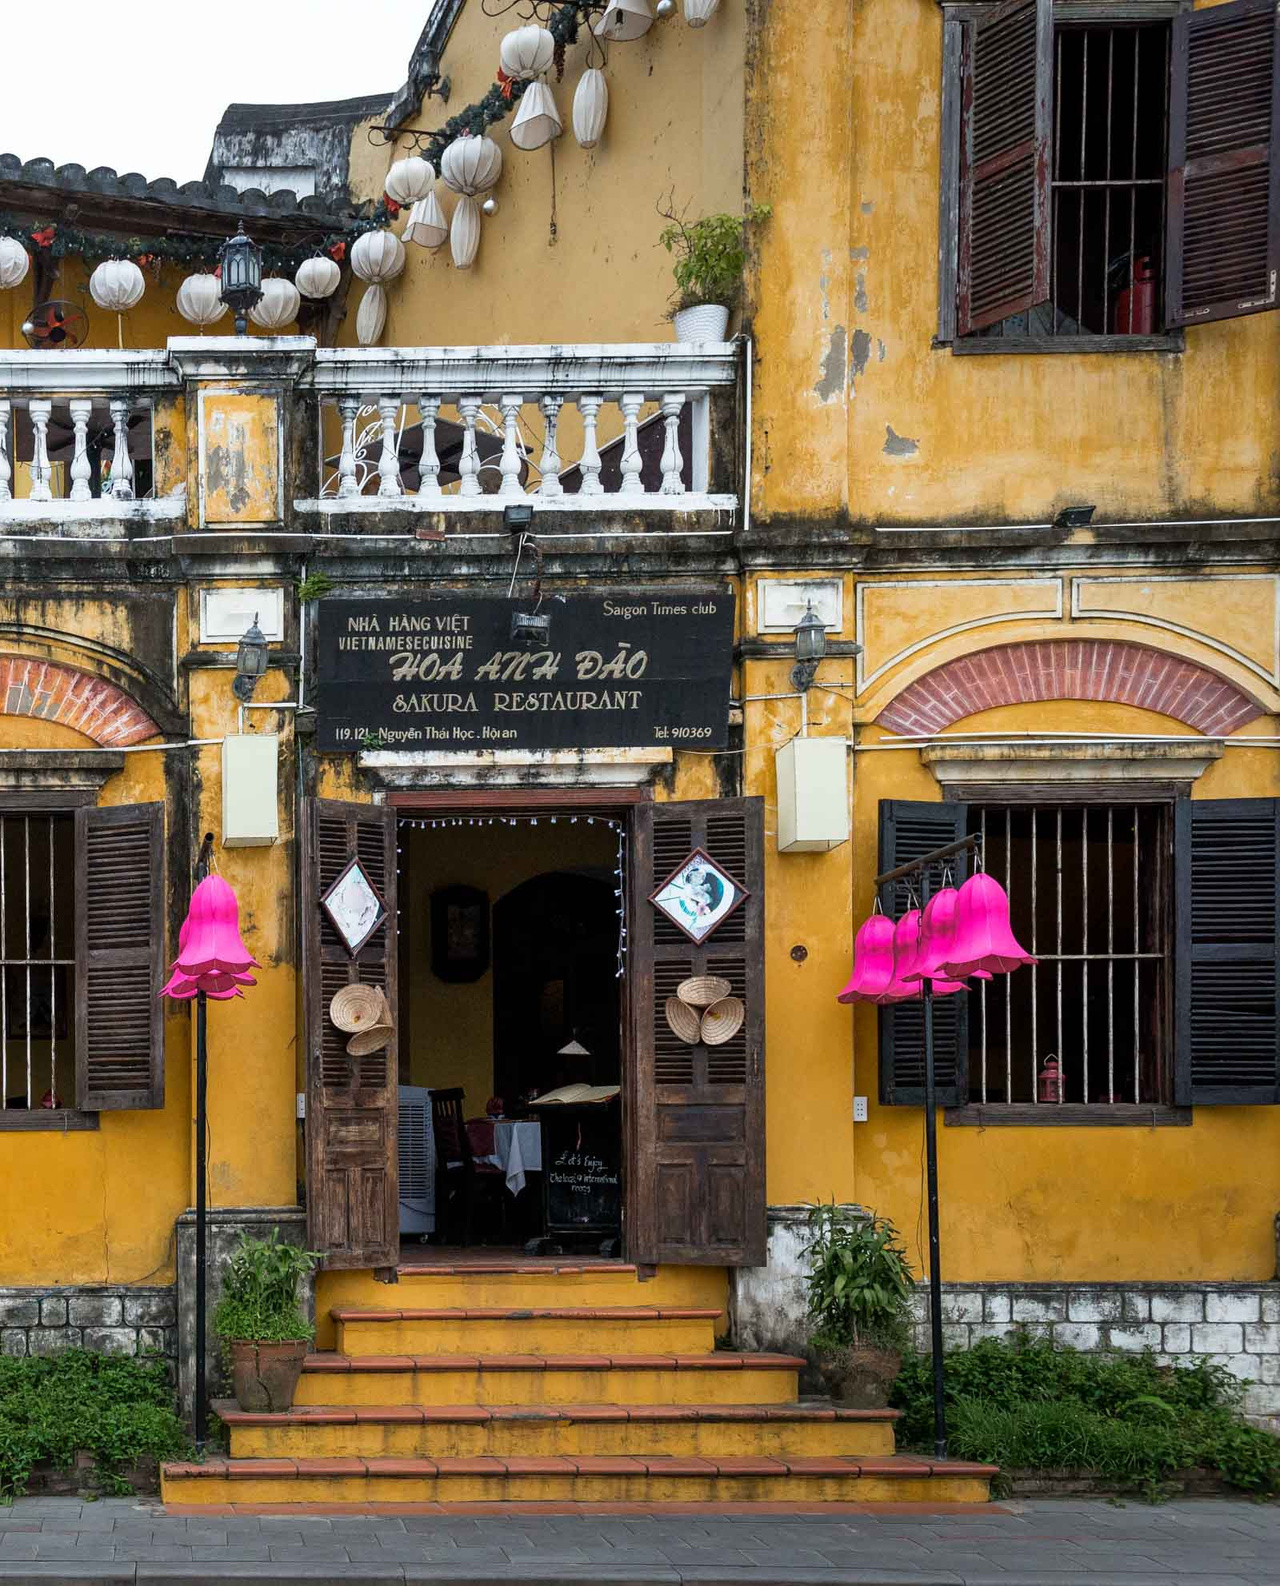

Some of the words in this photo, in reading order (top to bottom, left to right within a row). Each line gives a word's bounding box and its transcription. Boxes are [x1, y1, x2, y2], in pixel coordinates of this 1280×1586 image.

[603, 600, 647, 620] Saigon
[651, 601, 687, 615] Times
[692, 601, 717, 615] club
[347, 613, 380, 632] NHÀ
[389, 613, 431, 632] HÀNG
[435, 613, 471, 634] VIỆT
[389, 651, 465, 682] HOA
[474, 650, 562, 682] ANH
[391, 692, 479, 713] SAKURA
[493, 690, 643, 712] RESTAURANT
[653, 725, 670, 739] Tel:
[671, 727, 712, 739] 910369
